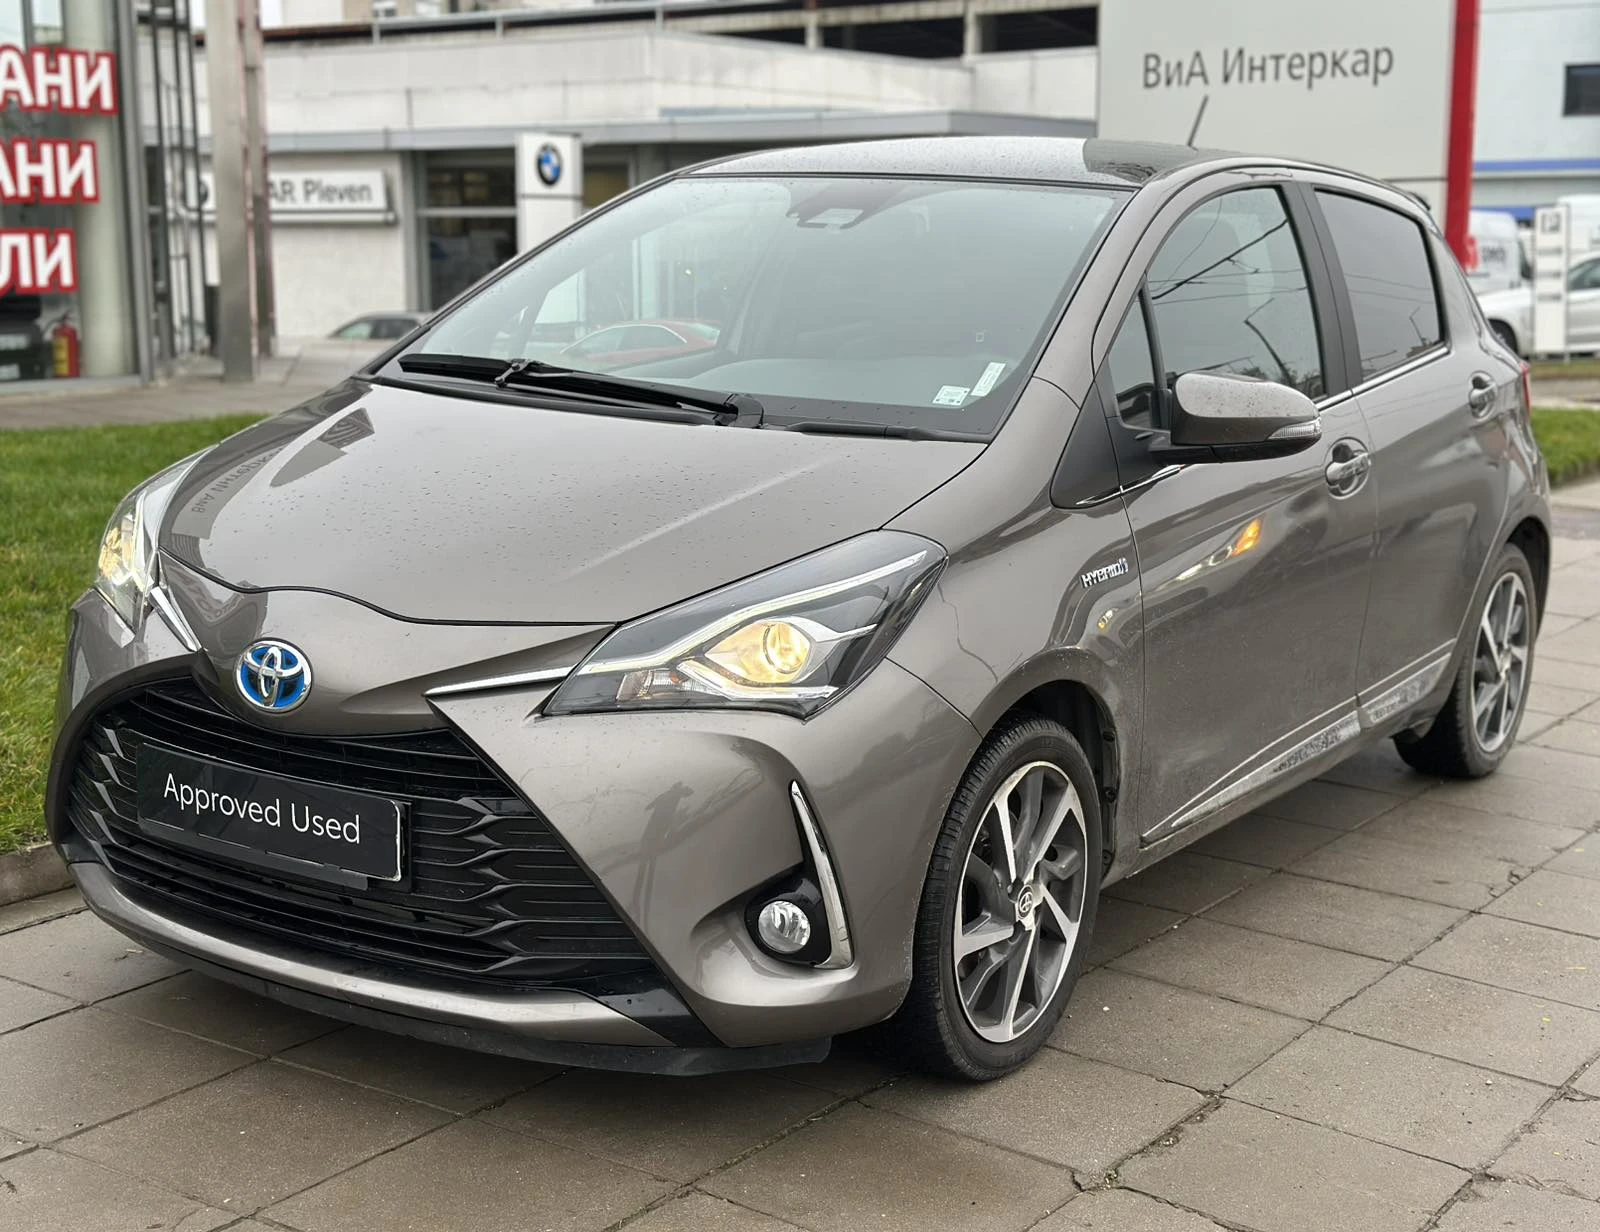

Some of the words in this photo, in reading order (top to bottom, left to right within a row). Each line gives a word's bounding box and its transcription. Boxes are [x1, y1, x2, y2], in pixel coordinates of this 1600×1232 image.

[1142, 51, 1209, 89] ВиА
[1221, 47, 1394, 90] Интеркар
[303, 180, 373, 202] Pleven
[1080, 561, 1125, 588] HYBRID
[163, 773, 281, 827] Approved
[291, 803, 361, 843] Used
